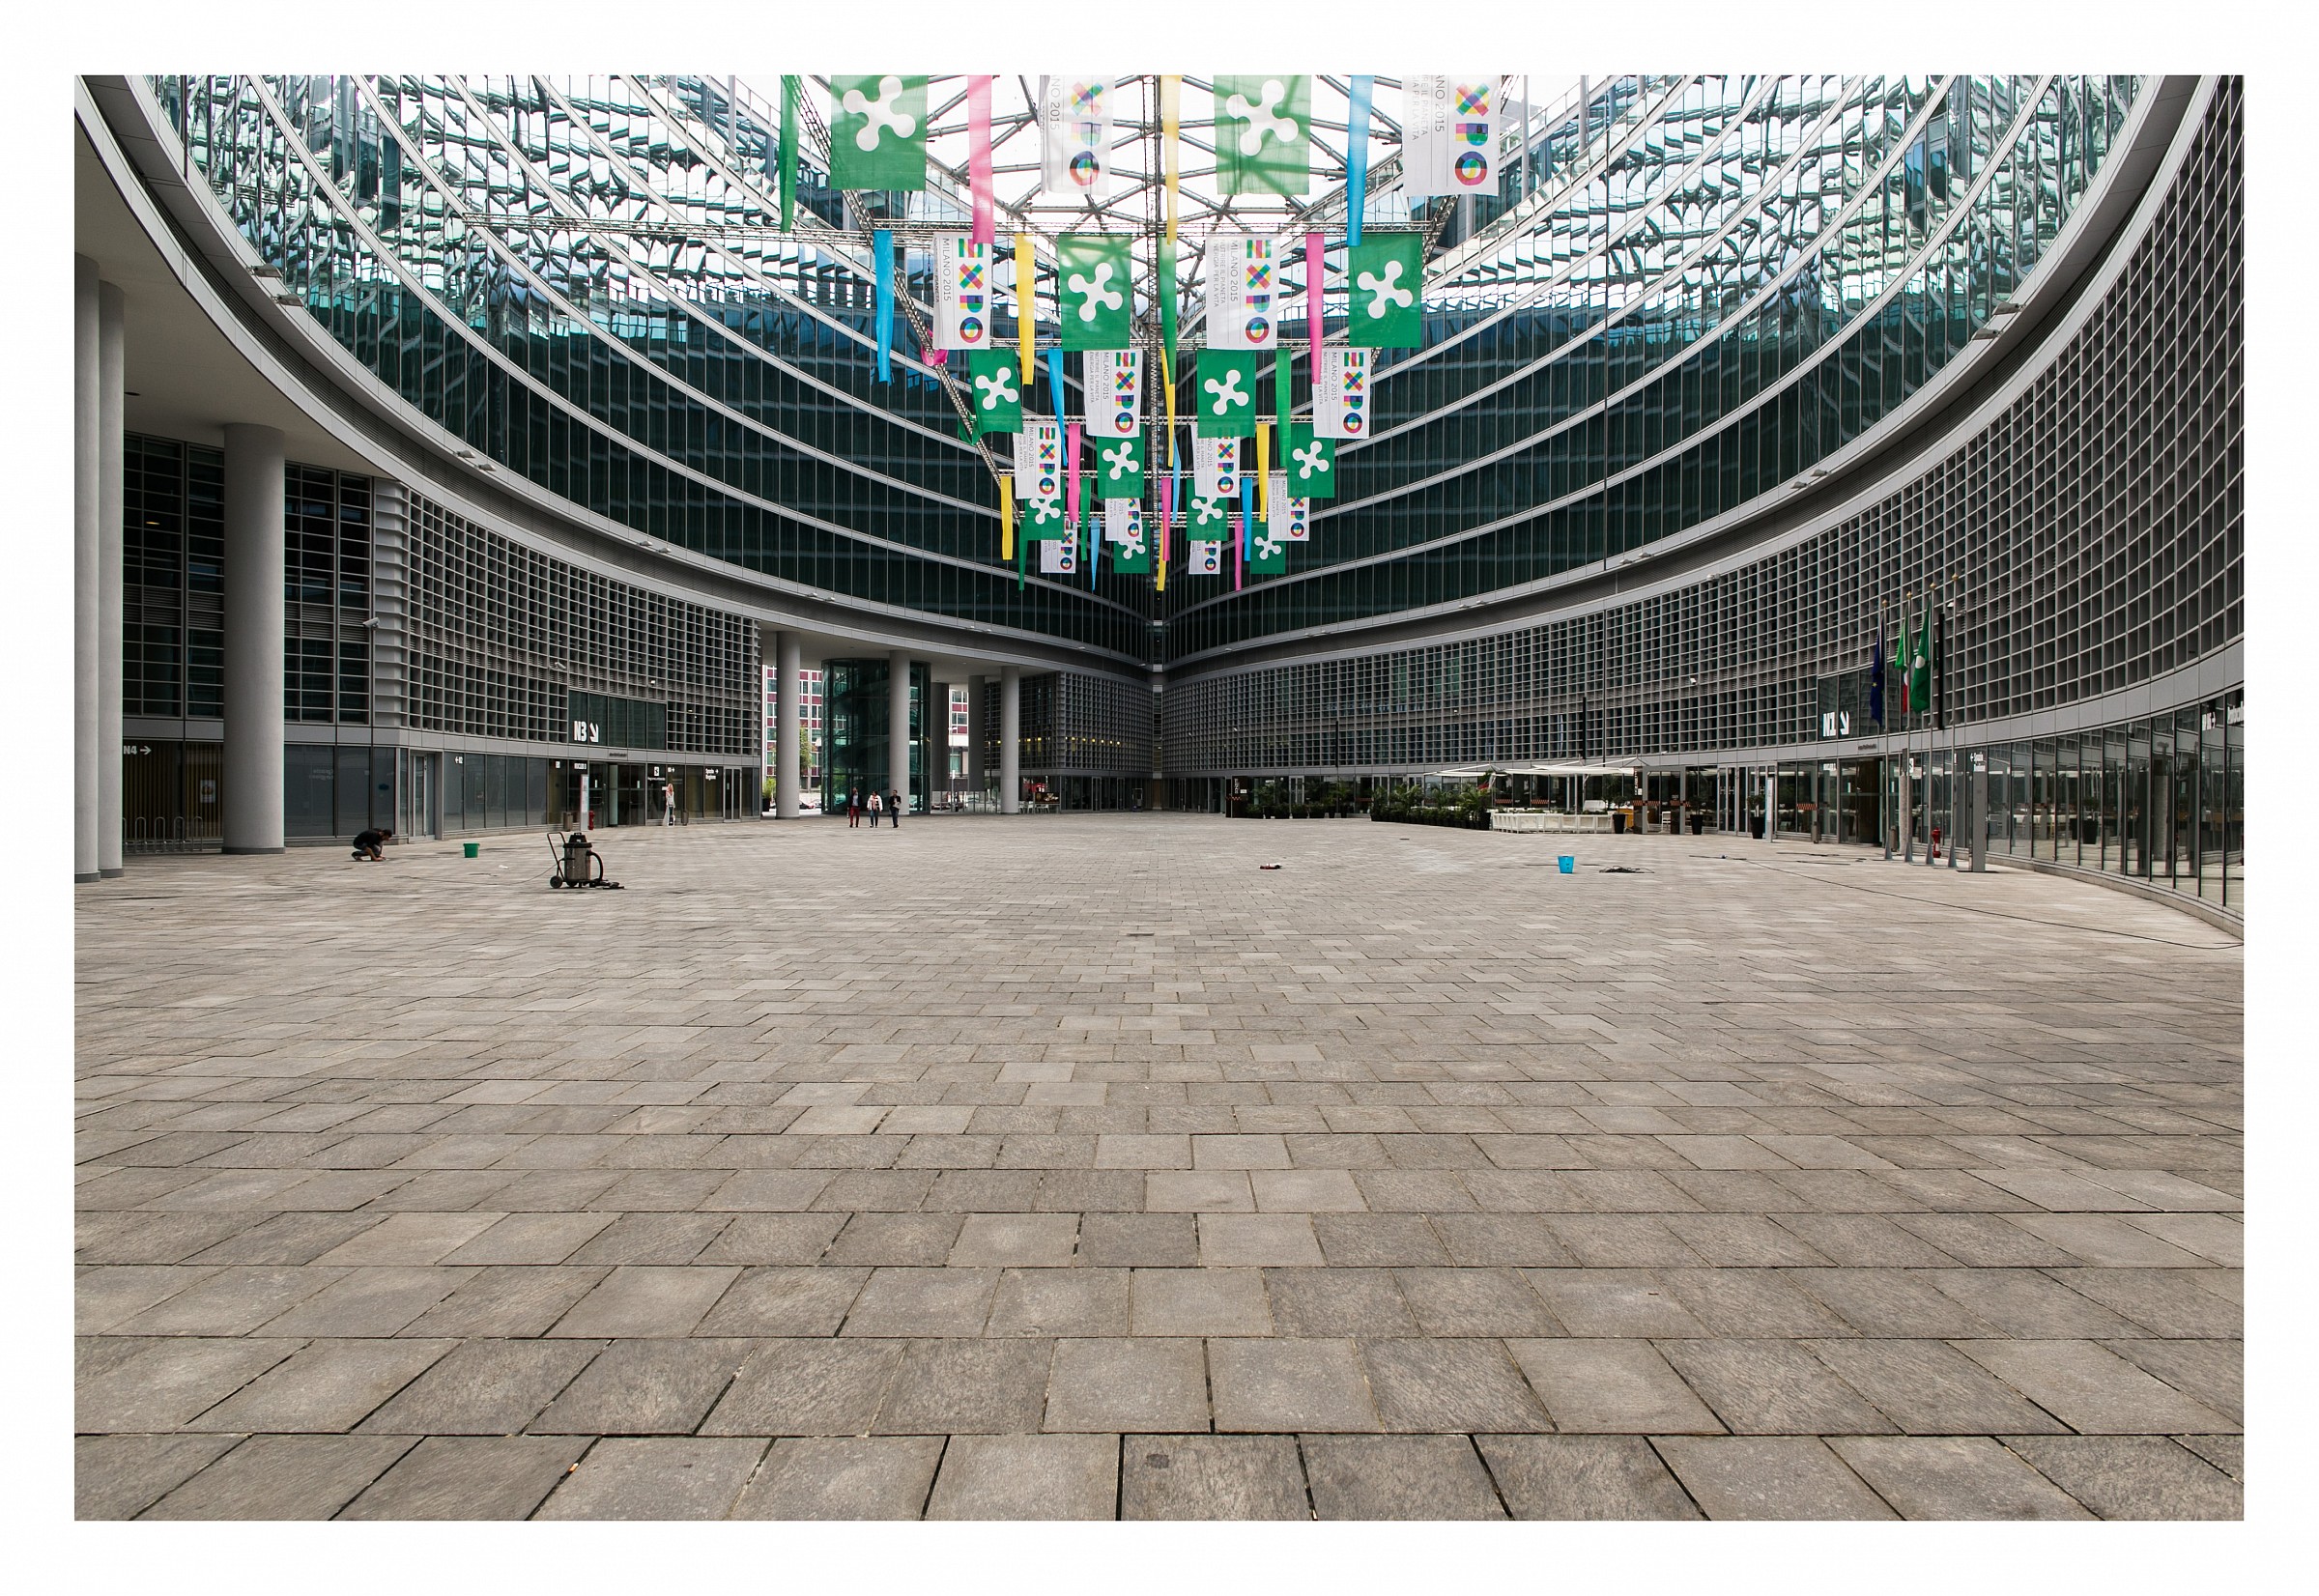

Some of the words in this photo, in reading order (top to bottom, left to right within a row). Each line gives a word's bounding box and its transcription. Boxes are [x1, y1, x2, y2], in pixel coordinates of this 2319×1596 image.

[1050, 101, 1061, 130] 2015
[1069, 82, 1103, 186] XPO
[1412, 121, 1420, 141] VITA
[1420, 100, 1429, 136] PIANETA
[1435, 103, 1446, 132] 2015
[1454, 82, 1490, 186] XPO
[942, 238, 951, 276] MILANO
[1230, 240, 1239, 277] MILANO
[943, 278, 952, 301] 2015
[959, 238, 984, 343] EXPO
[1230, 279, 1239, 302] 2015
[1245, 240, 1272, 343] EXPO
[1115, 352, 1135, 433] EXPO
[1343, 352, 1364, 433] EXPO
[1039, 427, 1055, 495] EXPO
[1217, 437, 1235, 494] XPO
[574, 720, 587, 742] N3
[123, 745, 138, 755] N4
